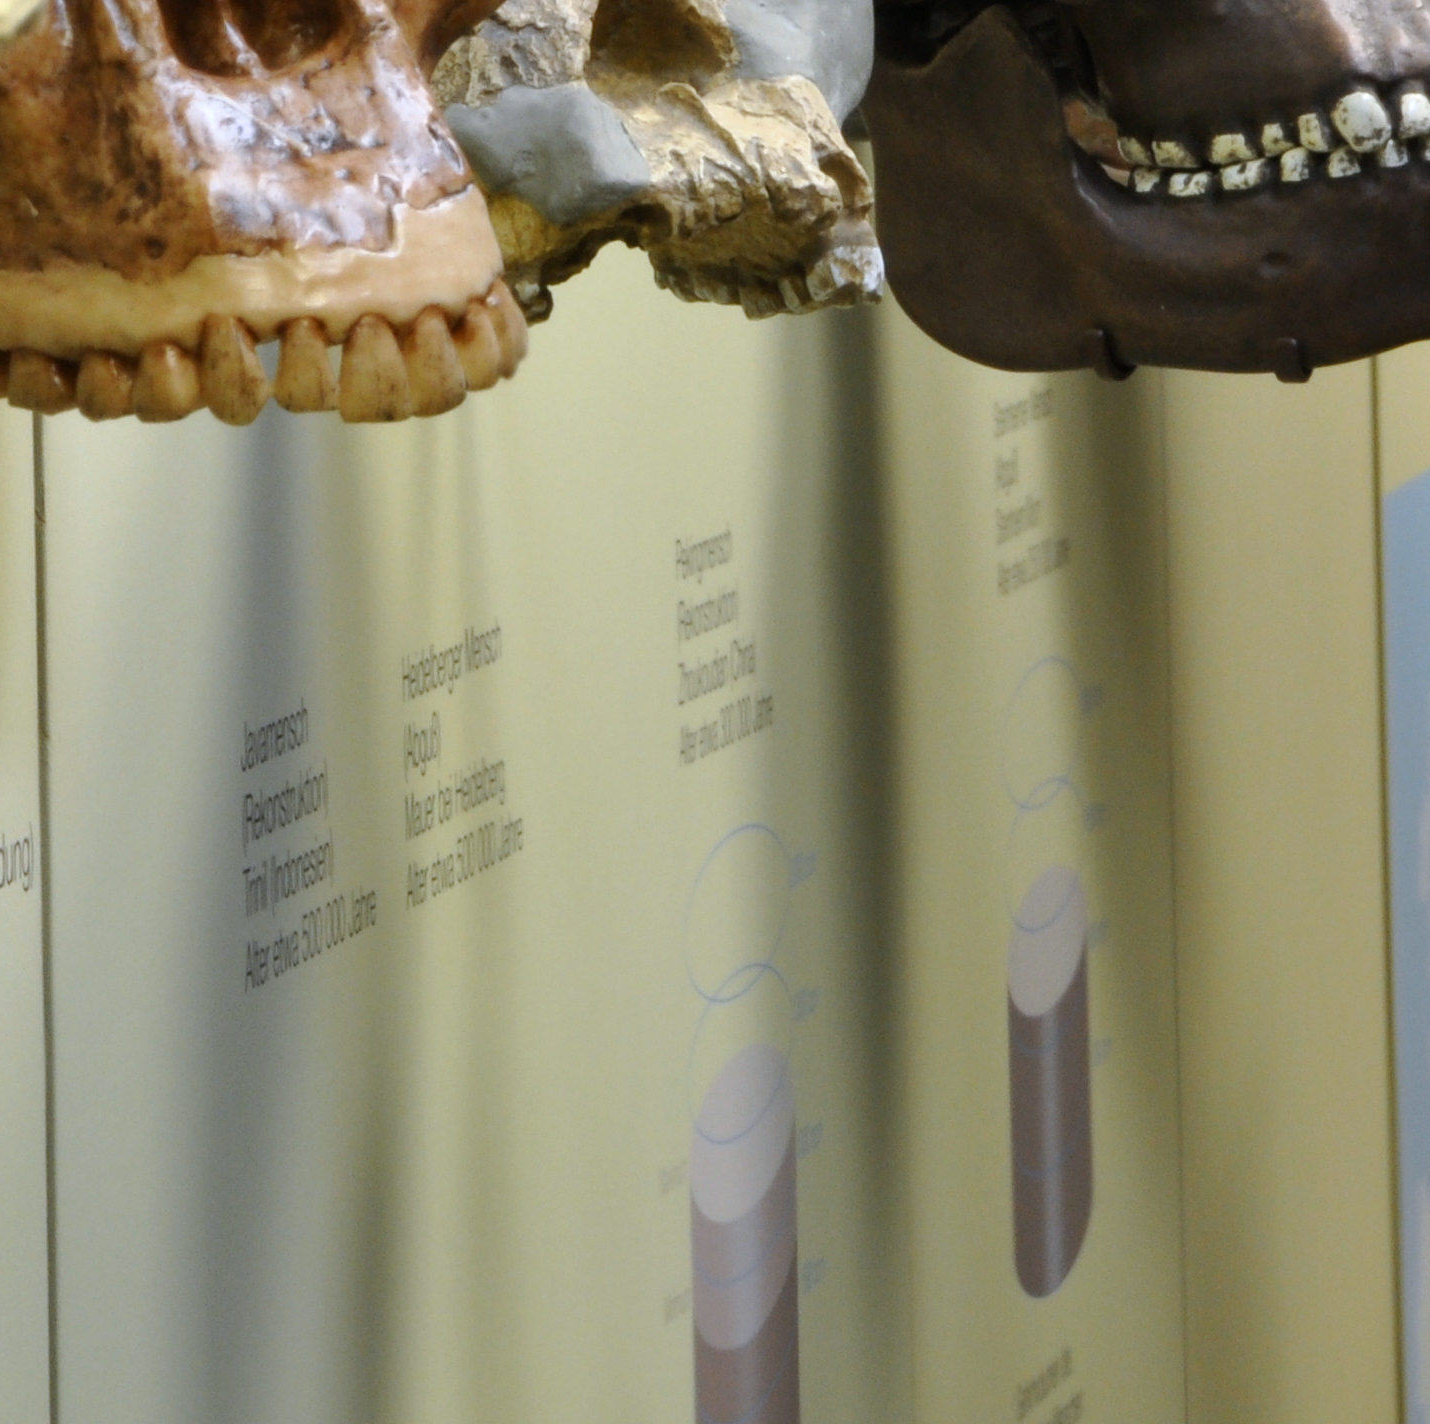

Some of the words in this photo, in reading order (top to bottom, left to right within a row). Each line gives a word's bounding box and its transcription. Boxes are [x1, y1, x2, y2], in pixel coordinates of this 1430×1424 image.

[241, 697, 309, 772] Javamensch
[406, 861, 428, 911] Alter
[245, 940, 270, 993] Alter
[273, 928, 299, 978] etwa
[349, 884, 377, 938] Jahre
